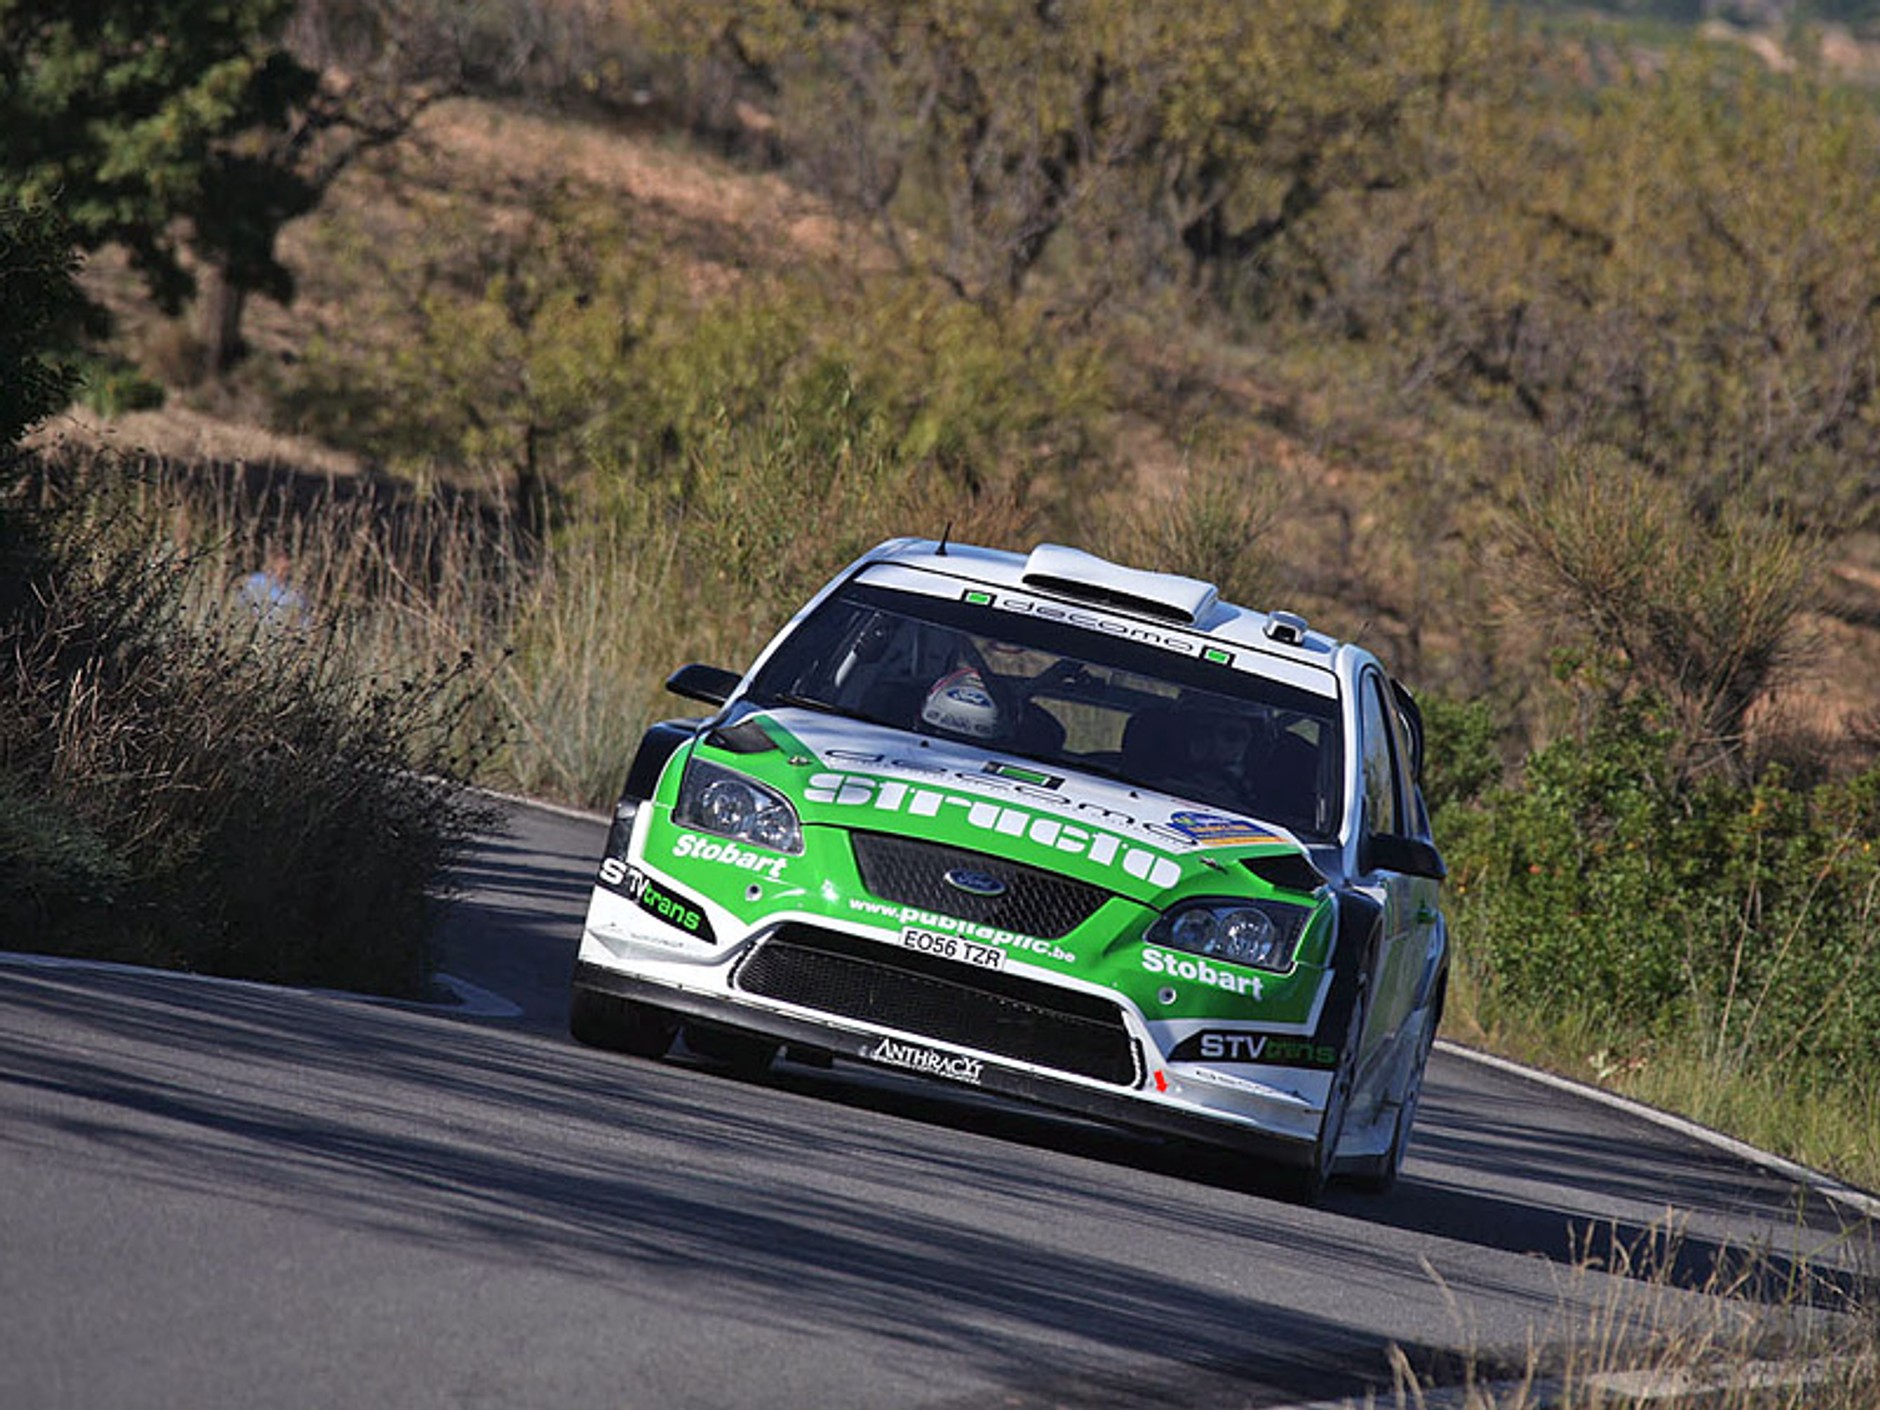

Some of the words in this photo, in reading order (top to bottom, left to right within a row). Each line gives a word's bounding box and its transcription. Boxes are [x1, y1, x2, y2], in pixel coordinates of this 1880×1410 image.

[672, 834, 787, 879] Stobart
[904, 930, 958, 957] EO56
[964, 943, 1001, 968] TZR
[1142, 948, 1264, 1001] Stobart
